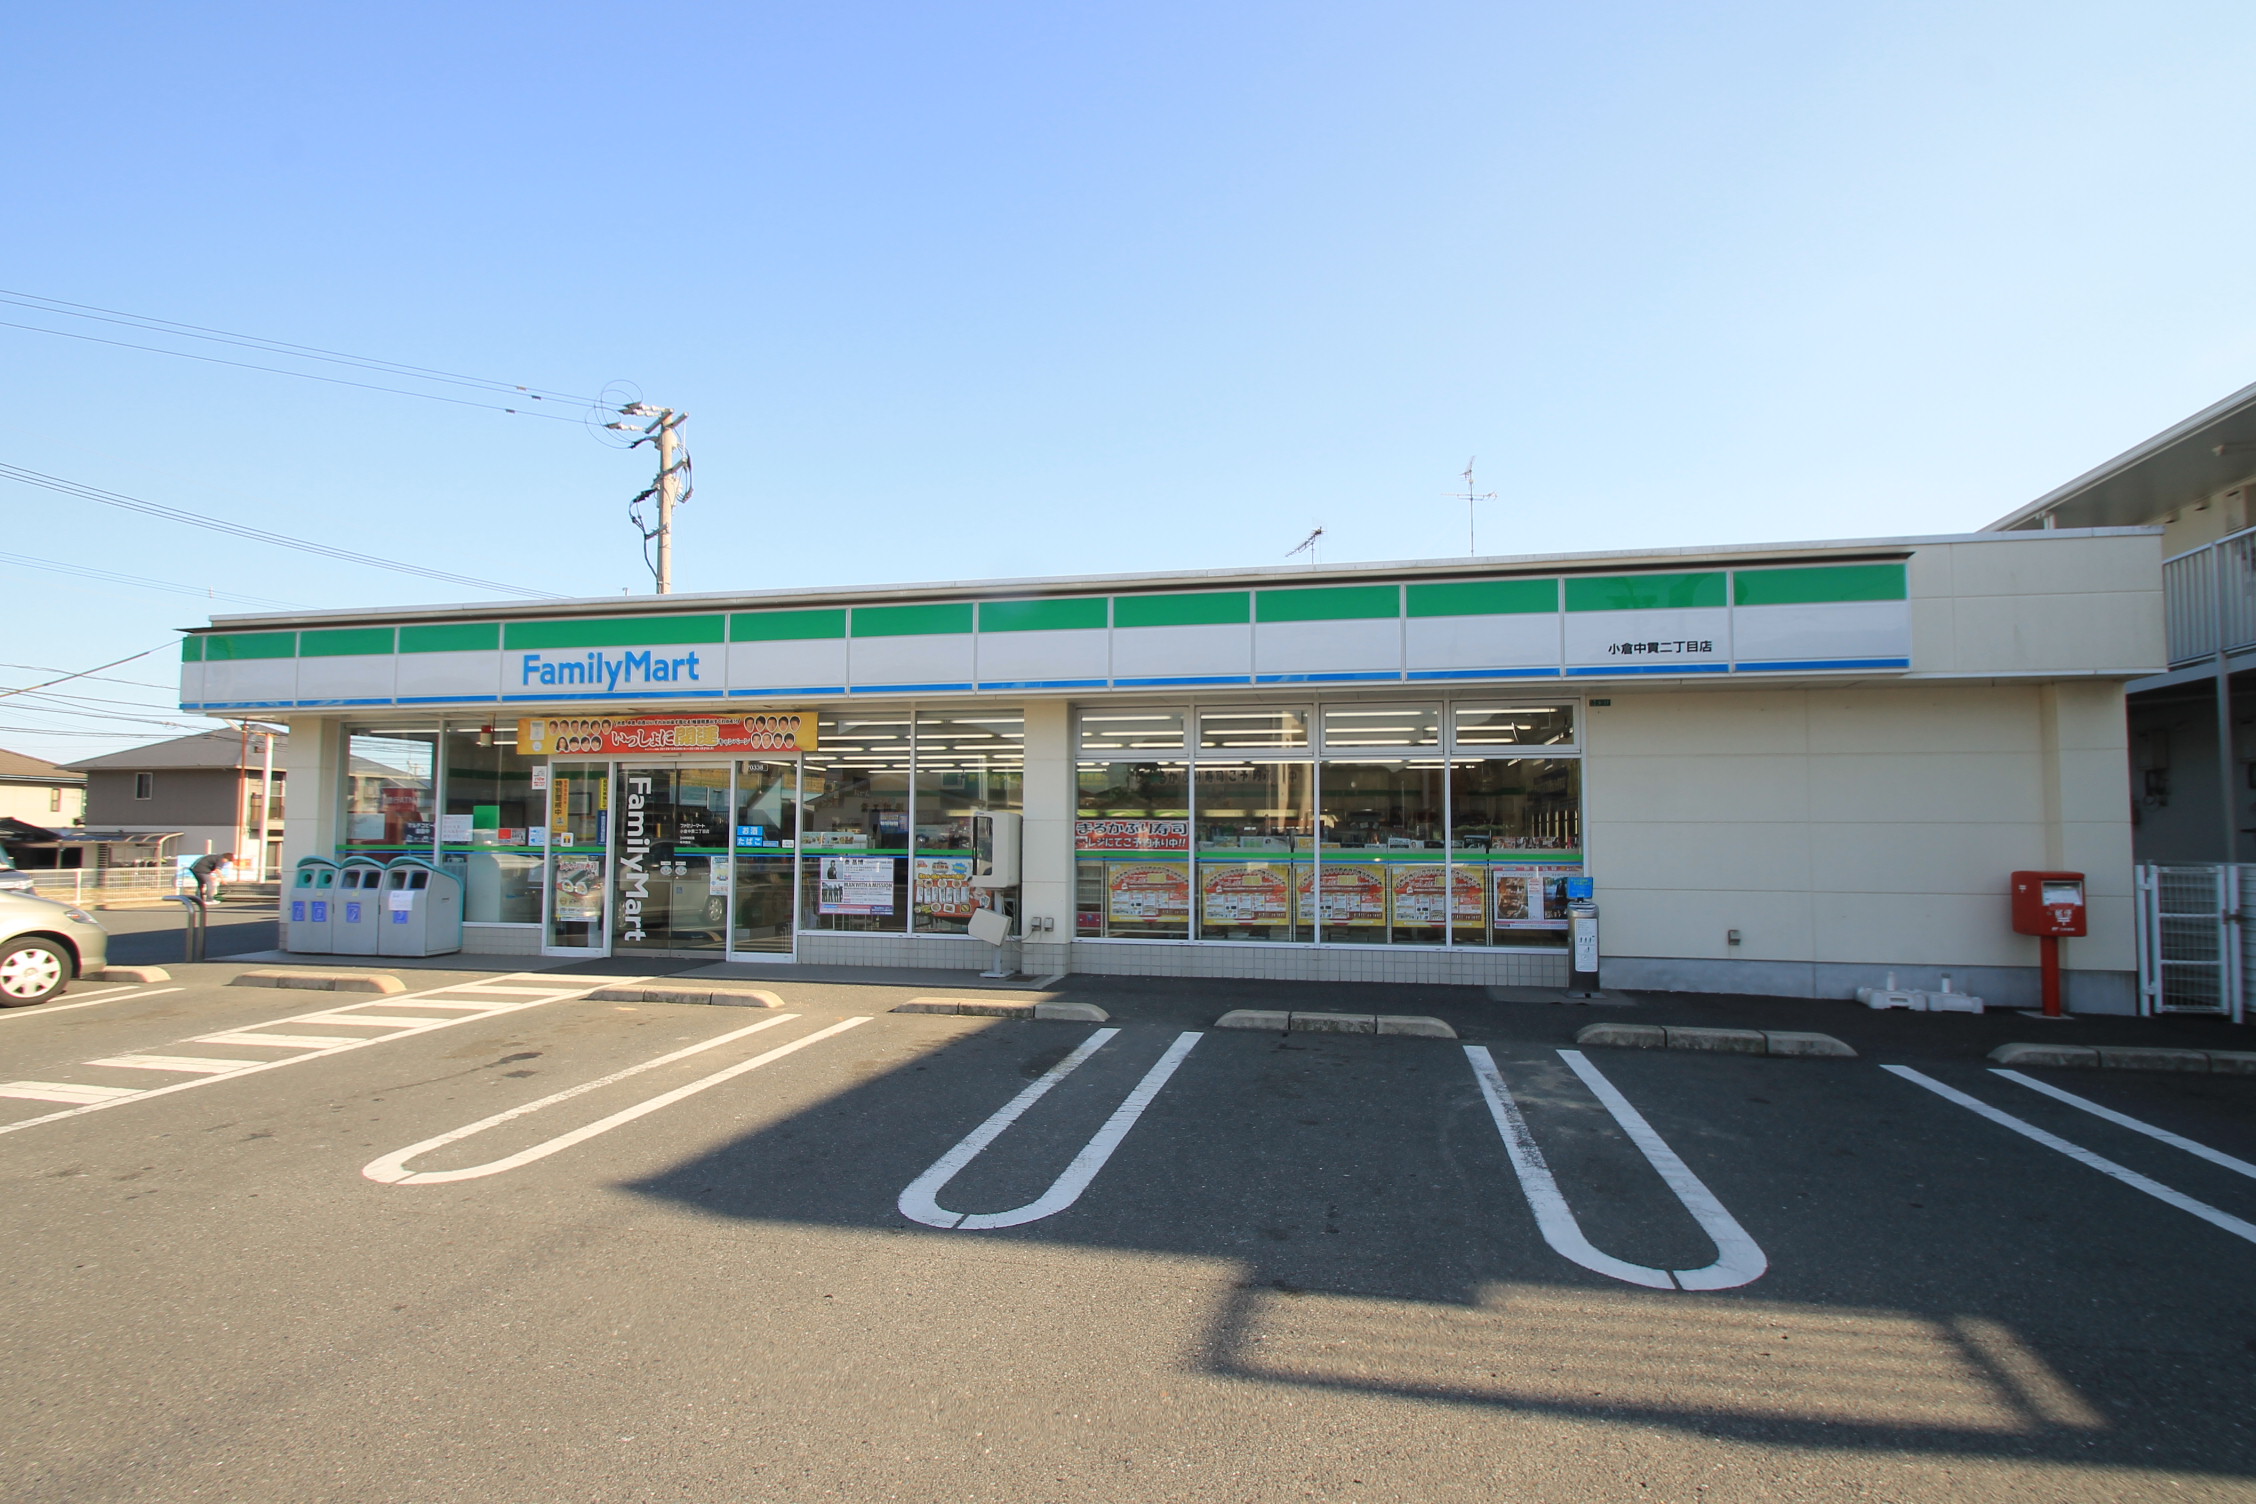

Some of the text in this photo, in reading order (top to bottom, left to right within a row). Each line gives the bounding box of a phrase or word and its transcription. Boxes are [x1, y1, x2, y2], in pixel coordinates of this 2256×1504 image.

[1608, 640, 1712, 655] 小倉中貫二丁目店
[522, 650, 700, 692] FamilyMart
[742, 826, 758, 836] お酒
[1075, 822, 1189, 836] まるかぶり寿司
[737, 837, 761, 846] たばこ
[620, 777, 652, 942] FamilyMart
